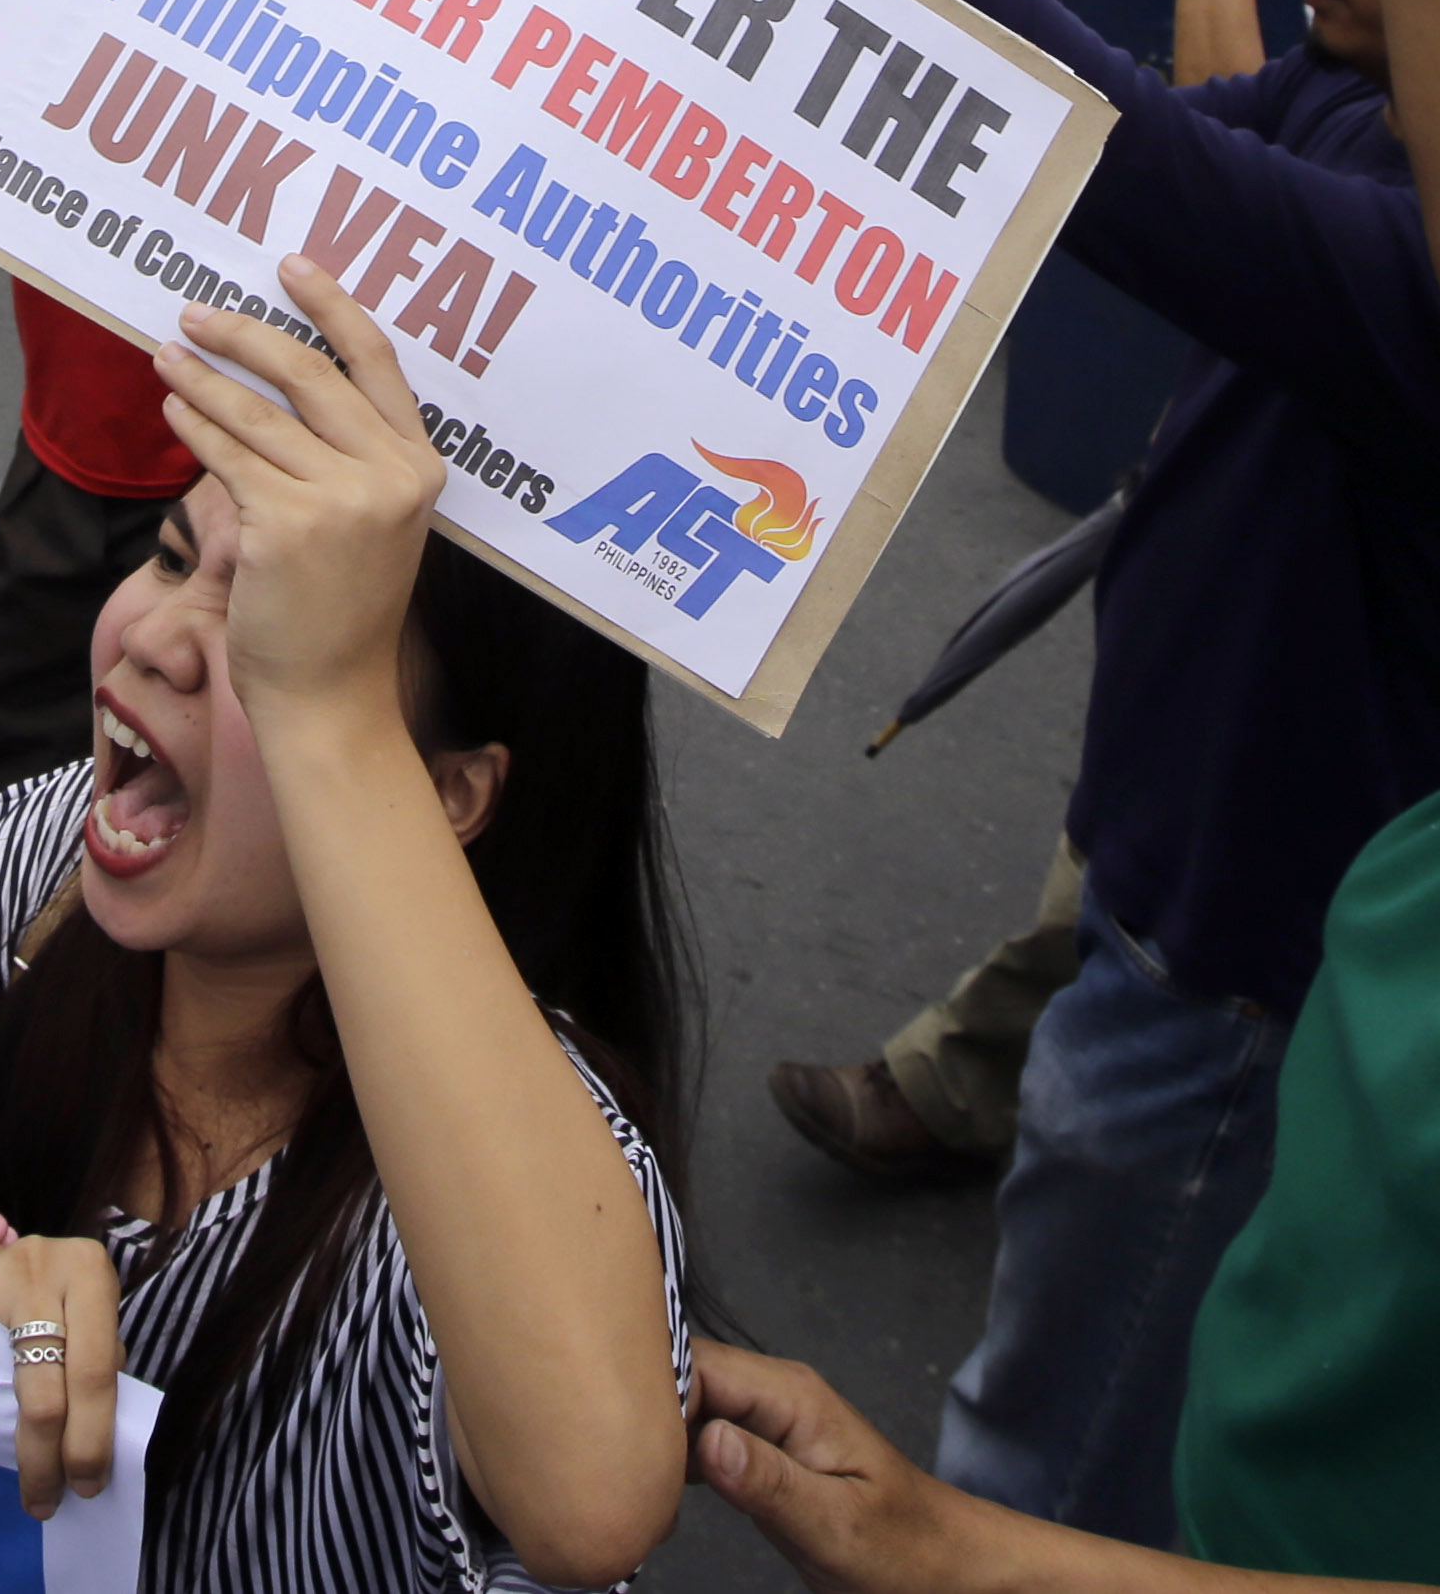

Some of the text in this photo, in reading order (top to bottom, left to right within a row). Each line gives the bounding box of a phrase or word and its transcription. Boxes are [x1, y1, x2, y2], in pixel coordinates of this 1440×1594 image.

[491, 5, 959, 354] PEMBERTON
[793, 0, 1012, 218] THE
[41, 32, 538, 380] JUNK VFA!
[86, 207, 144, 259] of
[472, 143, 879, 448] Authorities
[543, 452, 786, 621] ACT
[595, 541, 677, 602] PHILIPPINES
[651, 549, 688, 582] 1982
